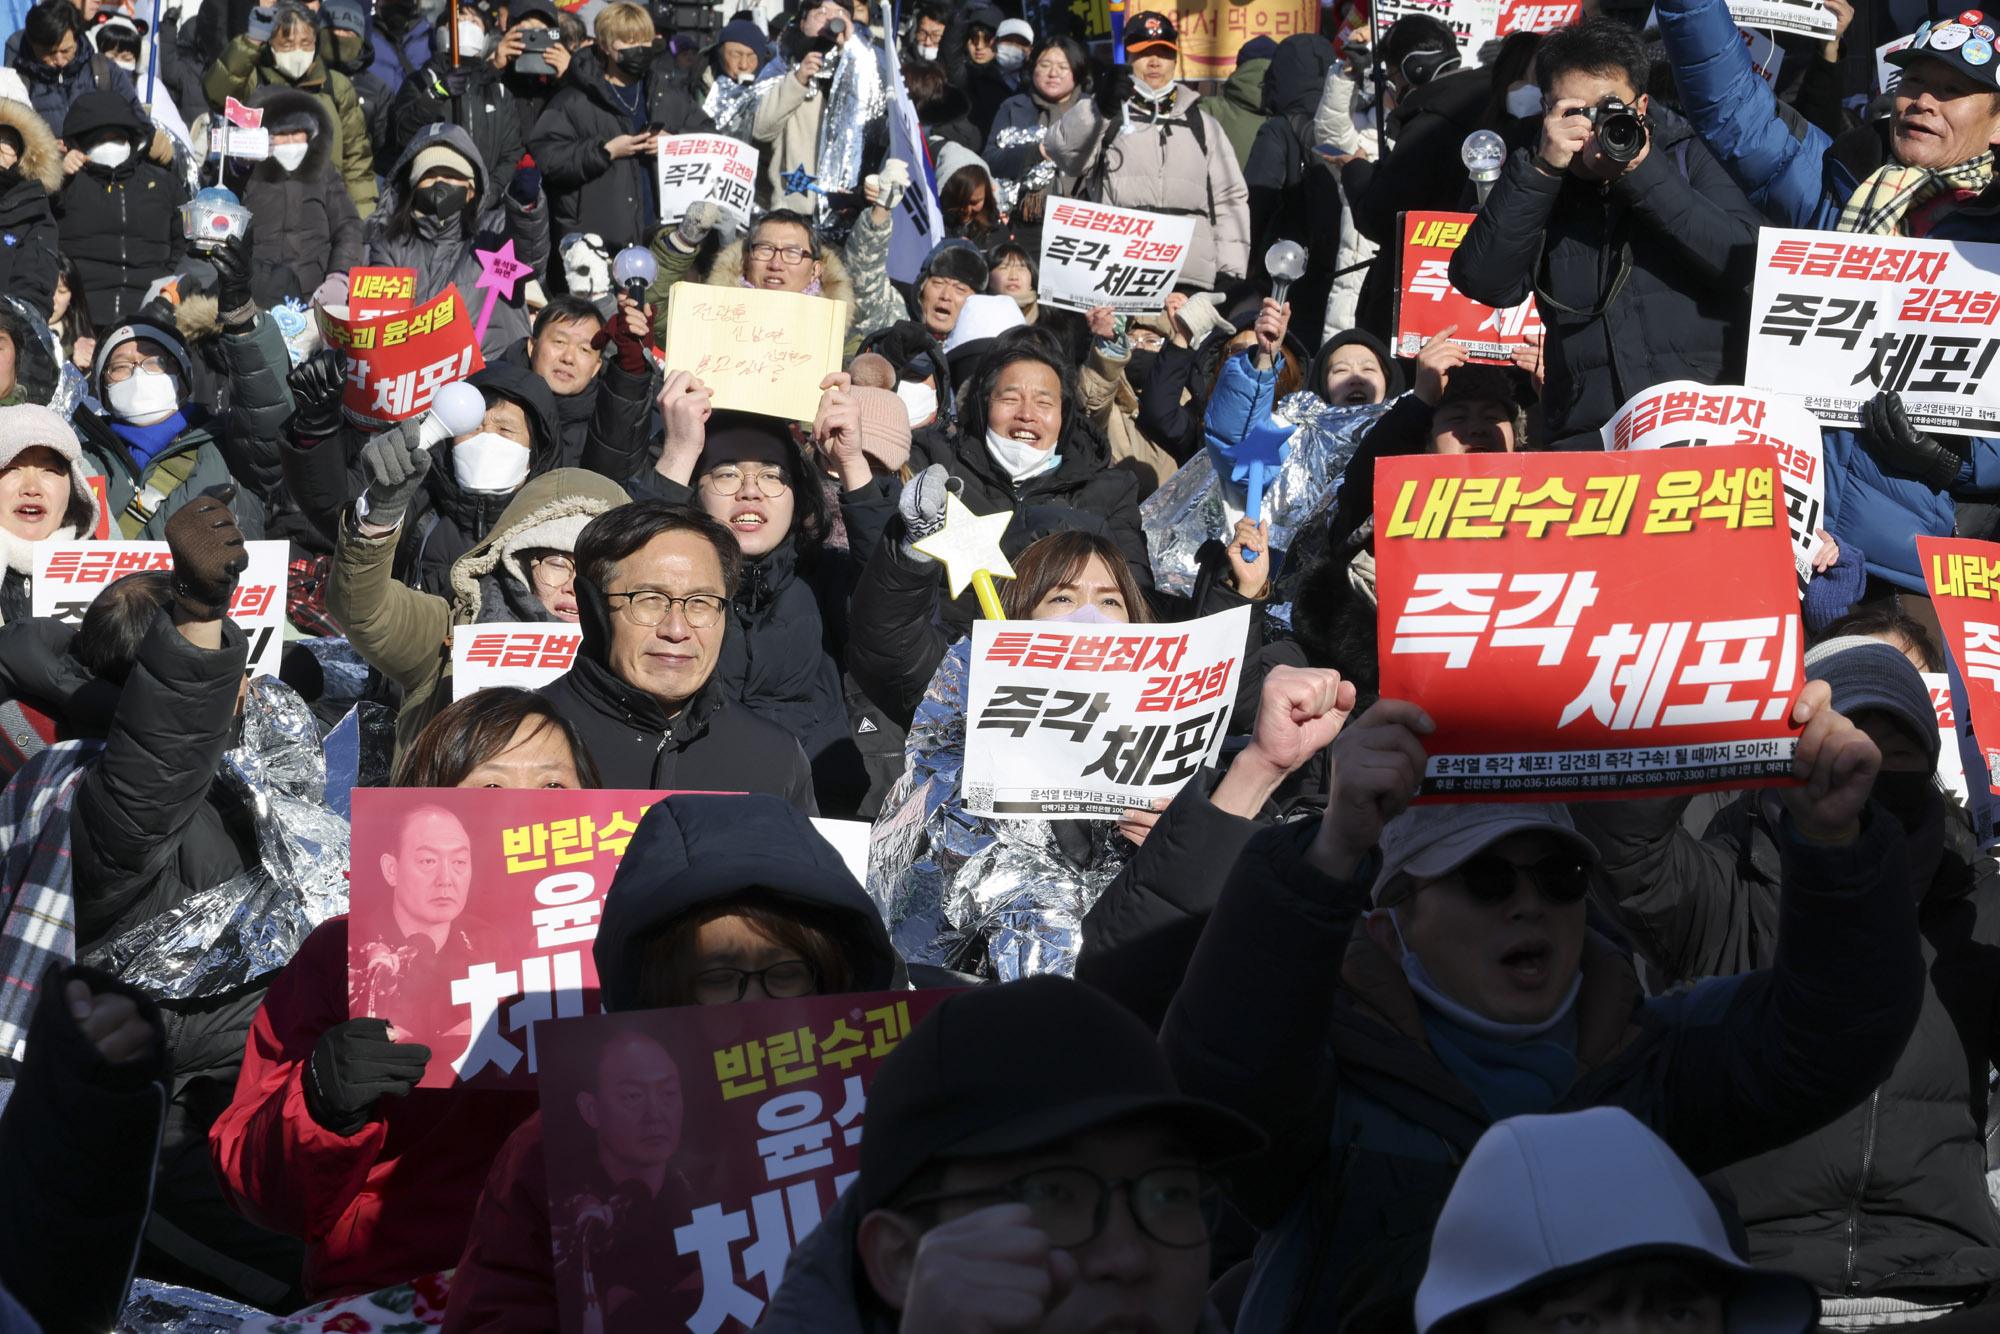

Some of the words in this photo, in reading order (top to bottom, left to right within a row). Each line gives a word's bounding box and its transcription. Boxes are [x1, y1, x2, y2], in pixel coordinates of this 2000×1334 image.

[1504, 3, 1583, 33] 체포!
[664, 139, 739, 159] 특급범죄자
[1468, 146, 1501, 160] aespa
[664, 162, 711, 188] 즉각
[722, 158, 754, 183] 김건희
[704, 176, 752, 213] 체포!
[1052, 204, 1155, 239] 특급범죄자
[1045, 235, 1111, 271] 즉각
[1122, 239, 1183, 263] 김건희
[1768, 240, 1950, 285] 특급범죄자
[352, 275, 414, 299] 내란수괴
[1093, 263, 1176, 298] 체포!
[382, 294, 455, 348] 윤석열
[1758, 293, 1879, 351] 즉각
[1897, 288, 2000, 326] 김건희
[1849, 332, 2000, 396] 체포!
[1613, 391, 1767, 450] 특급범죄자
[1803, 396, 1831, 408] 윤석열
[1833, 398, 1865, 410] 탄핵기
[1385, 474, 1641, 539] 내란수괴
[1642, 467, 1774, 534] 윤석열
[1391, 570, 1600, 669] 즉각
[466, 633, 582, 669] 특급범
[984, 632, 1190, 673] 특급범죄자
[1134, 657, 1236, 713] 김건희
[1557, 613, 1799, 730] 체포!
[976, 685, 1112, 743] 즉각
[1080, 704, 1229, 787] 체포!
[1436, 757, 1480, 774] 윤석열
[1485, 756, 1514, 773] 즉각
[1518, 755, 1553, 772] 체포!
[1558, 753, 1601, 771] 김건희
[1605, 751, 1634, 769] 즉각
[1637, 750, 1670, 767] 구속!
[1691, 745, 1731, 763] 때까지
[1734, 741, 1779, 760] 모이자!
[1435, 779, 1454, 790] 후원
[1464, 778, 1501, 790] 신한은행
[1504, 776, 1579, 789] 100-036-164860
[1625, 773, 1644, 784] ARS
[1645, 769, 1704, 783] 060-707-3300
[1766, 761, 1784, 772] 여러
[1030, 789, 1060, 801] 윤석열
[1063, 789, 1103, 803] 탄핵기금
[1105, 793, 1126, 805] 모금
[1041, 804, 1066, 812] 탄핵기금
[1067, 804, 1080, 812] 모금
[1086, 804, 1111, 813] 신한은행
[502, 806, 648, 874] 반란수
[713, 1000, 912, 1101] 반란수괴
